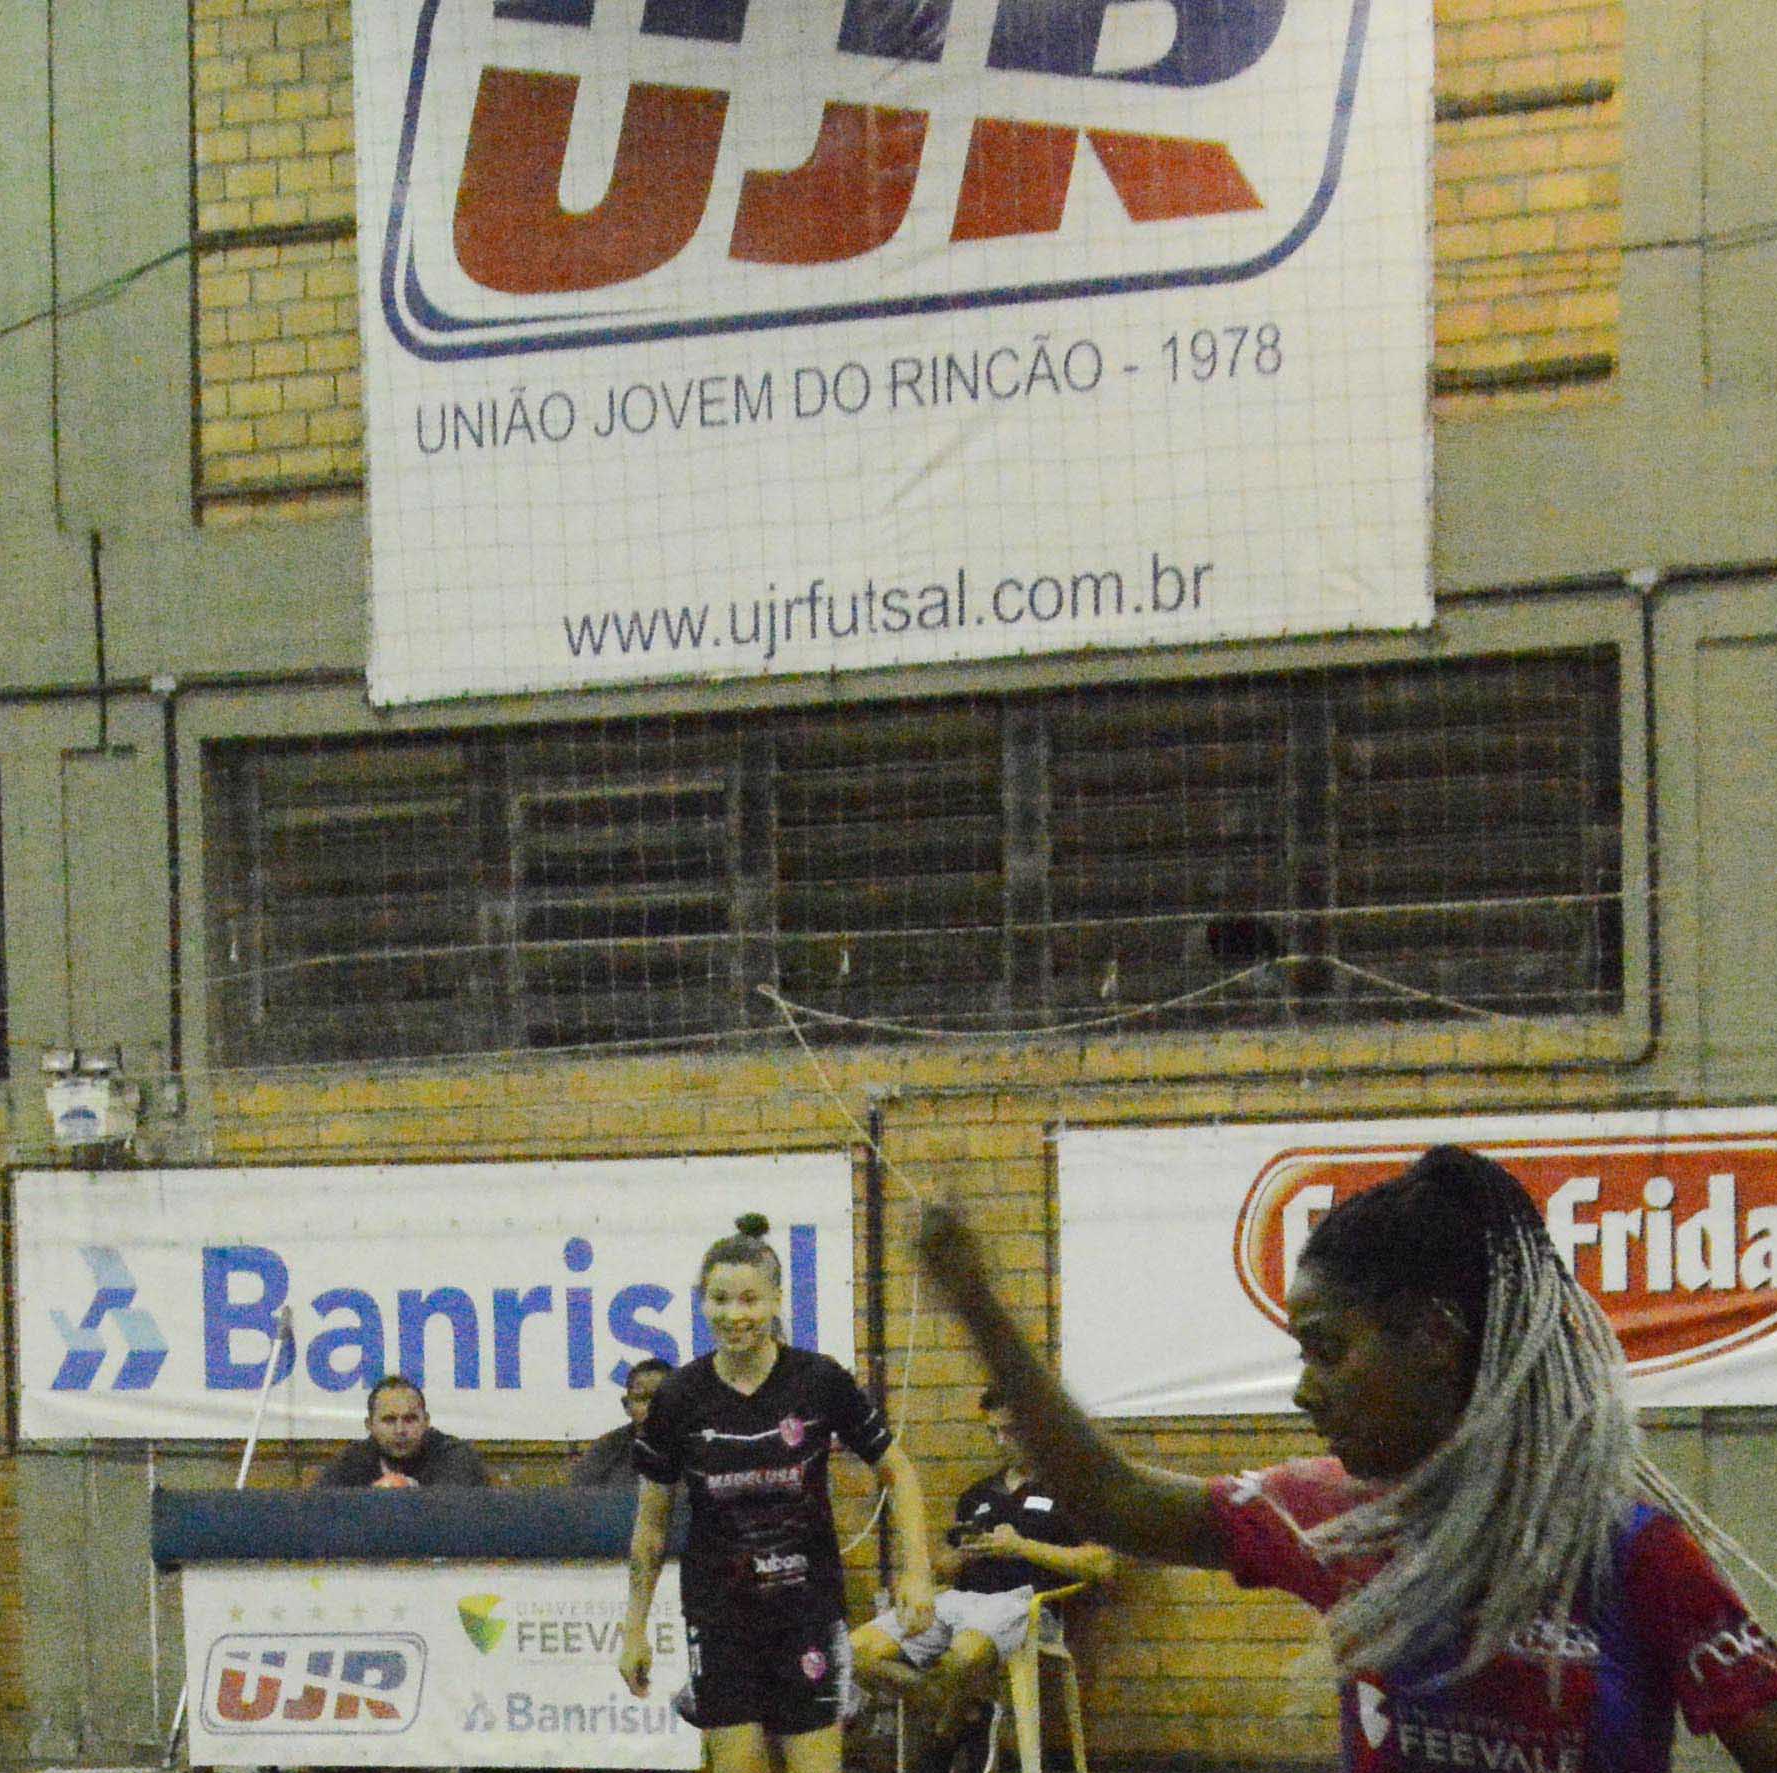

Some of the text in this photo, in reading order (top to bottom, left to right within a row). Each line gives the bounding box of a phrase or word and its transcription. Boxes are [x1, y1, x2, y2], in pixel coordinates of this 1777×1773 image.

[452, 0, 1290, 295] UJR
[416, 386, 574, 455] UNIÃO
[593, 371, 774, 438] JOVEM
[794, 359, 870, 419] DO
[890, 332, 1104, 406] RINCÃO
[1161, 323, 1284, 384] 1978
[563, 552, 1214, 660] www.ujrfutsal.com.br
[202, 1224, 819, 1393] Banrisl
[215, 1650, 408, 1722] UJR
